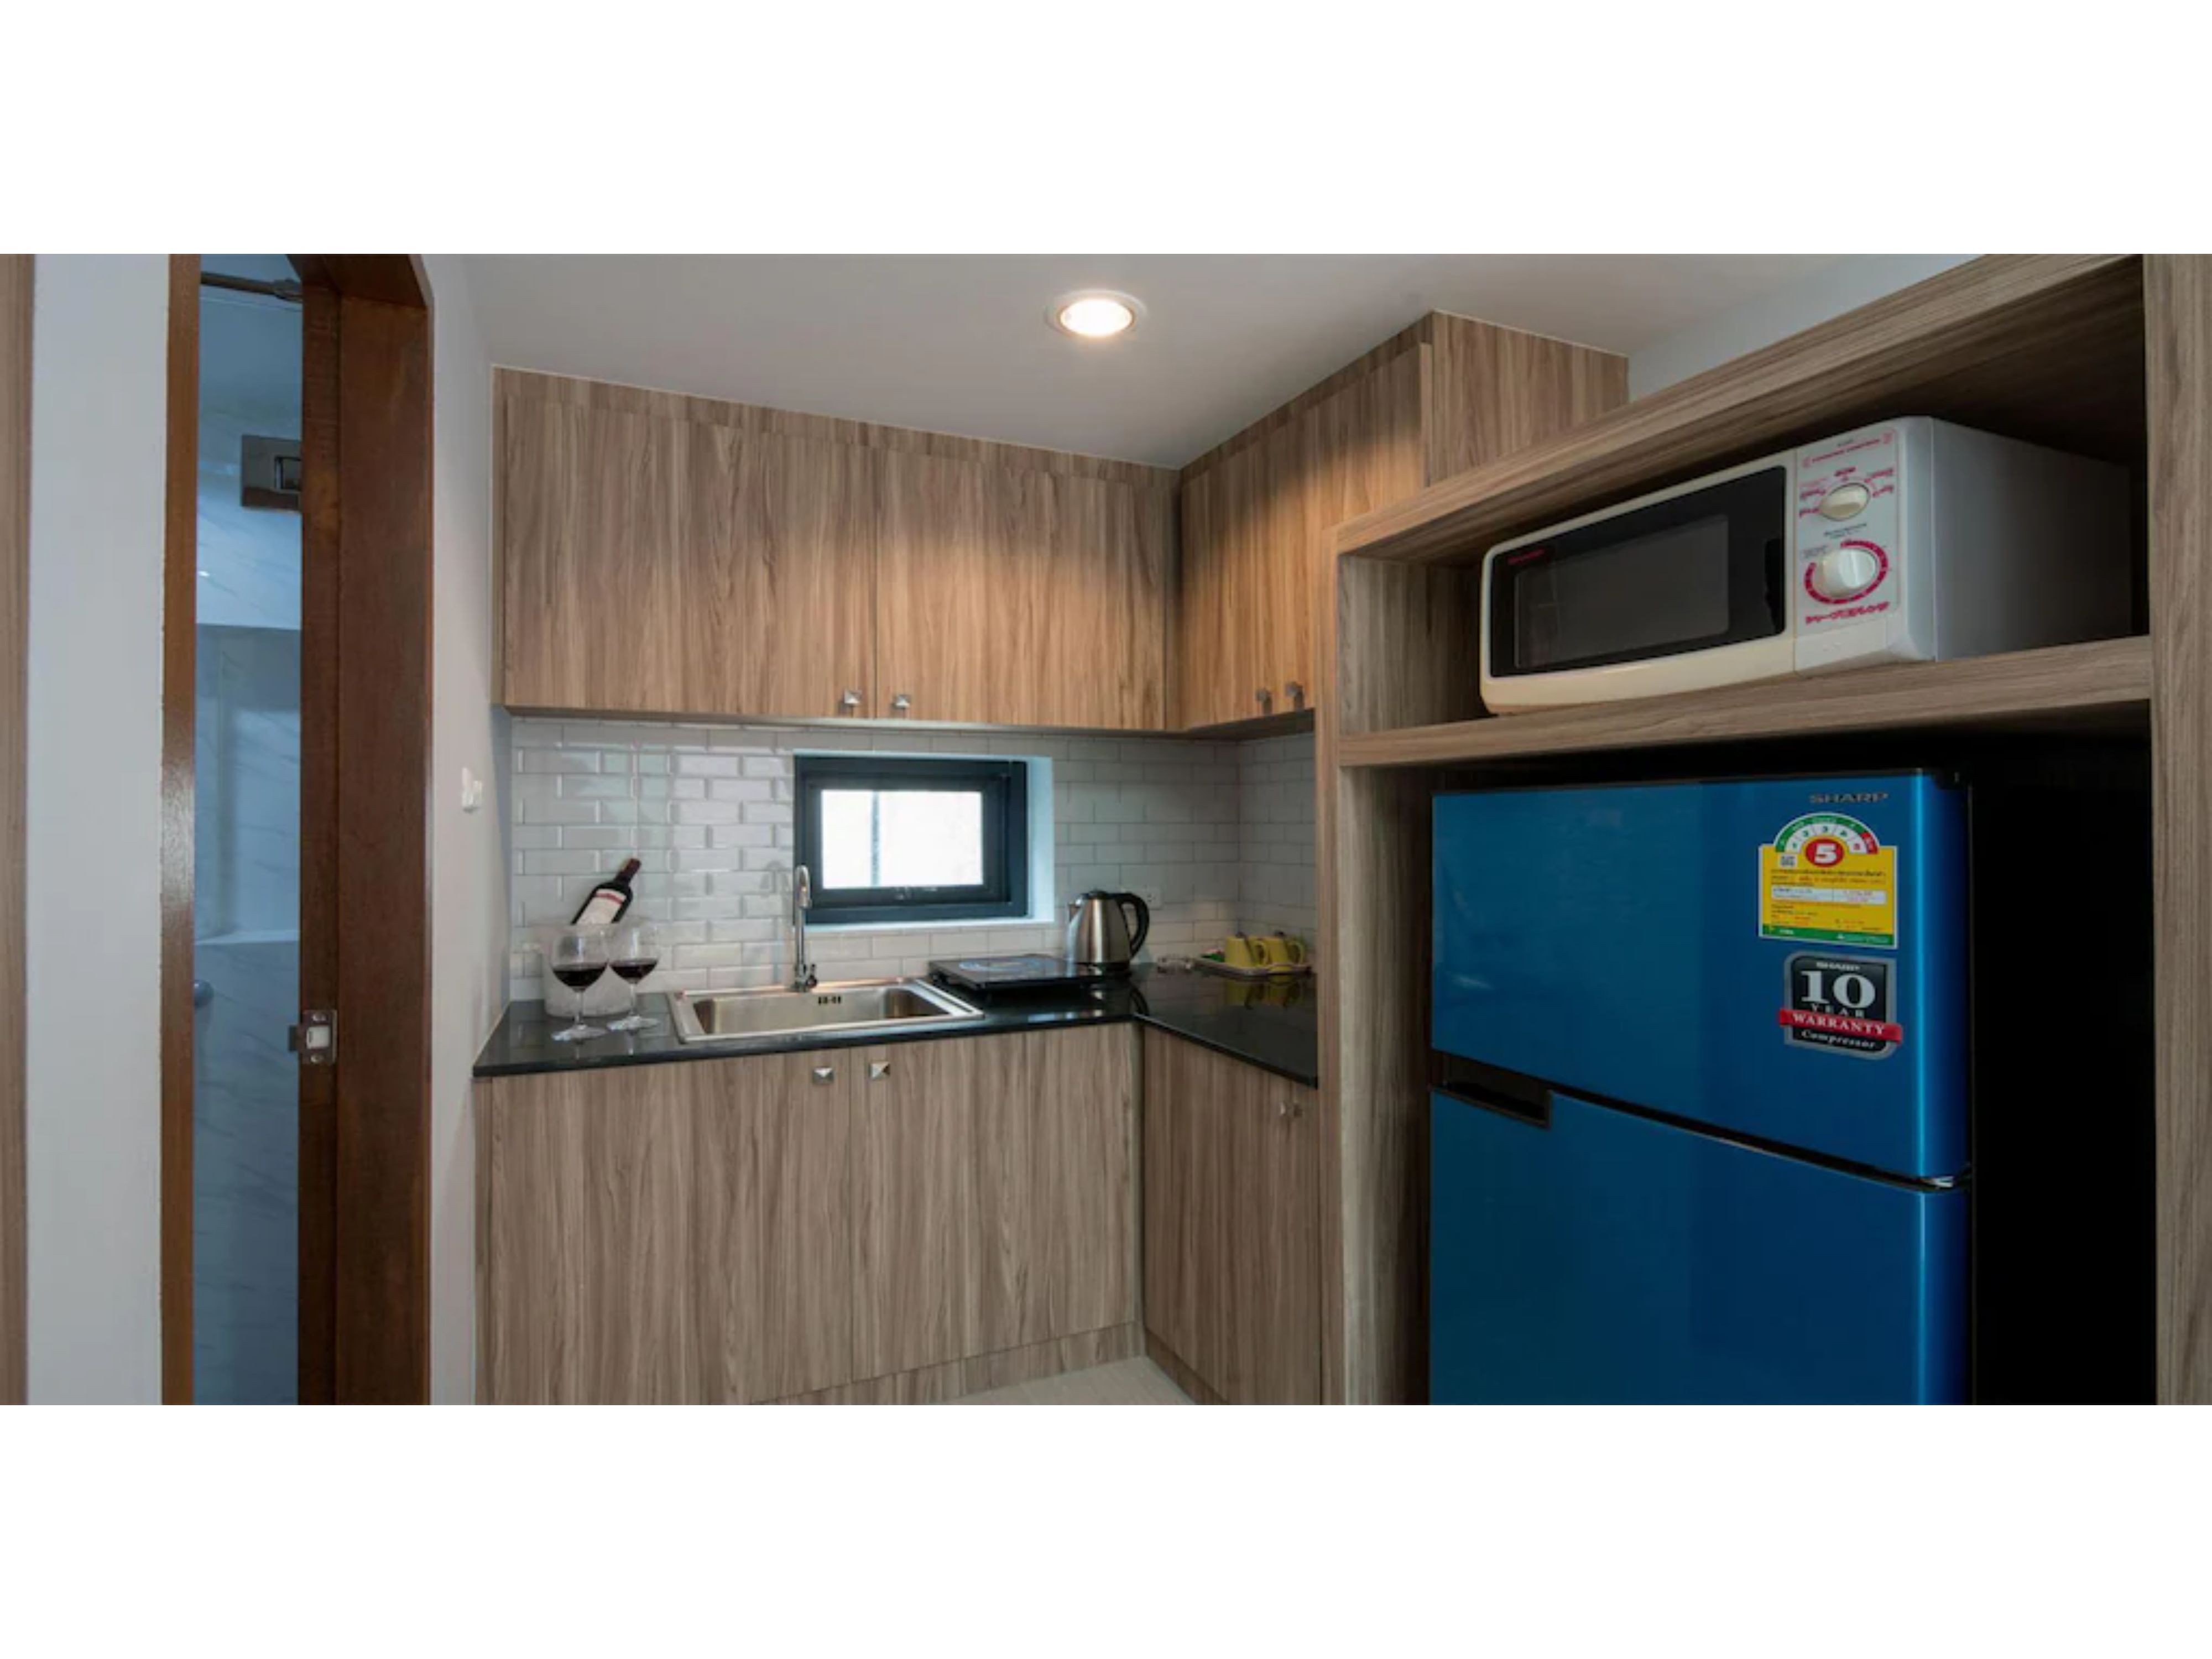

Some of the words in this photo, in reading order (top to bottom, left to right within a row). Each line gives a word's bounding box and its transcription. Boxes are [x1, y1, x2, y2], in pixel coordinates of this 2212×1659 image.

[1809, 792, 1888, 804] SHARP
[1814, 843, 1837, 864] 5
[1801, 971, 1876, 1009] 10
[1811, 1004, 1865, 1018] YEAR
[1792, 1013, 1885, 1035] WARRANTY
[1801, 1029, 1876, 1048] Compressor
